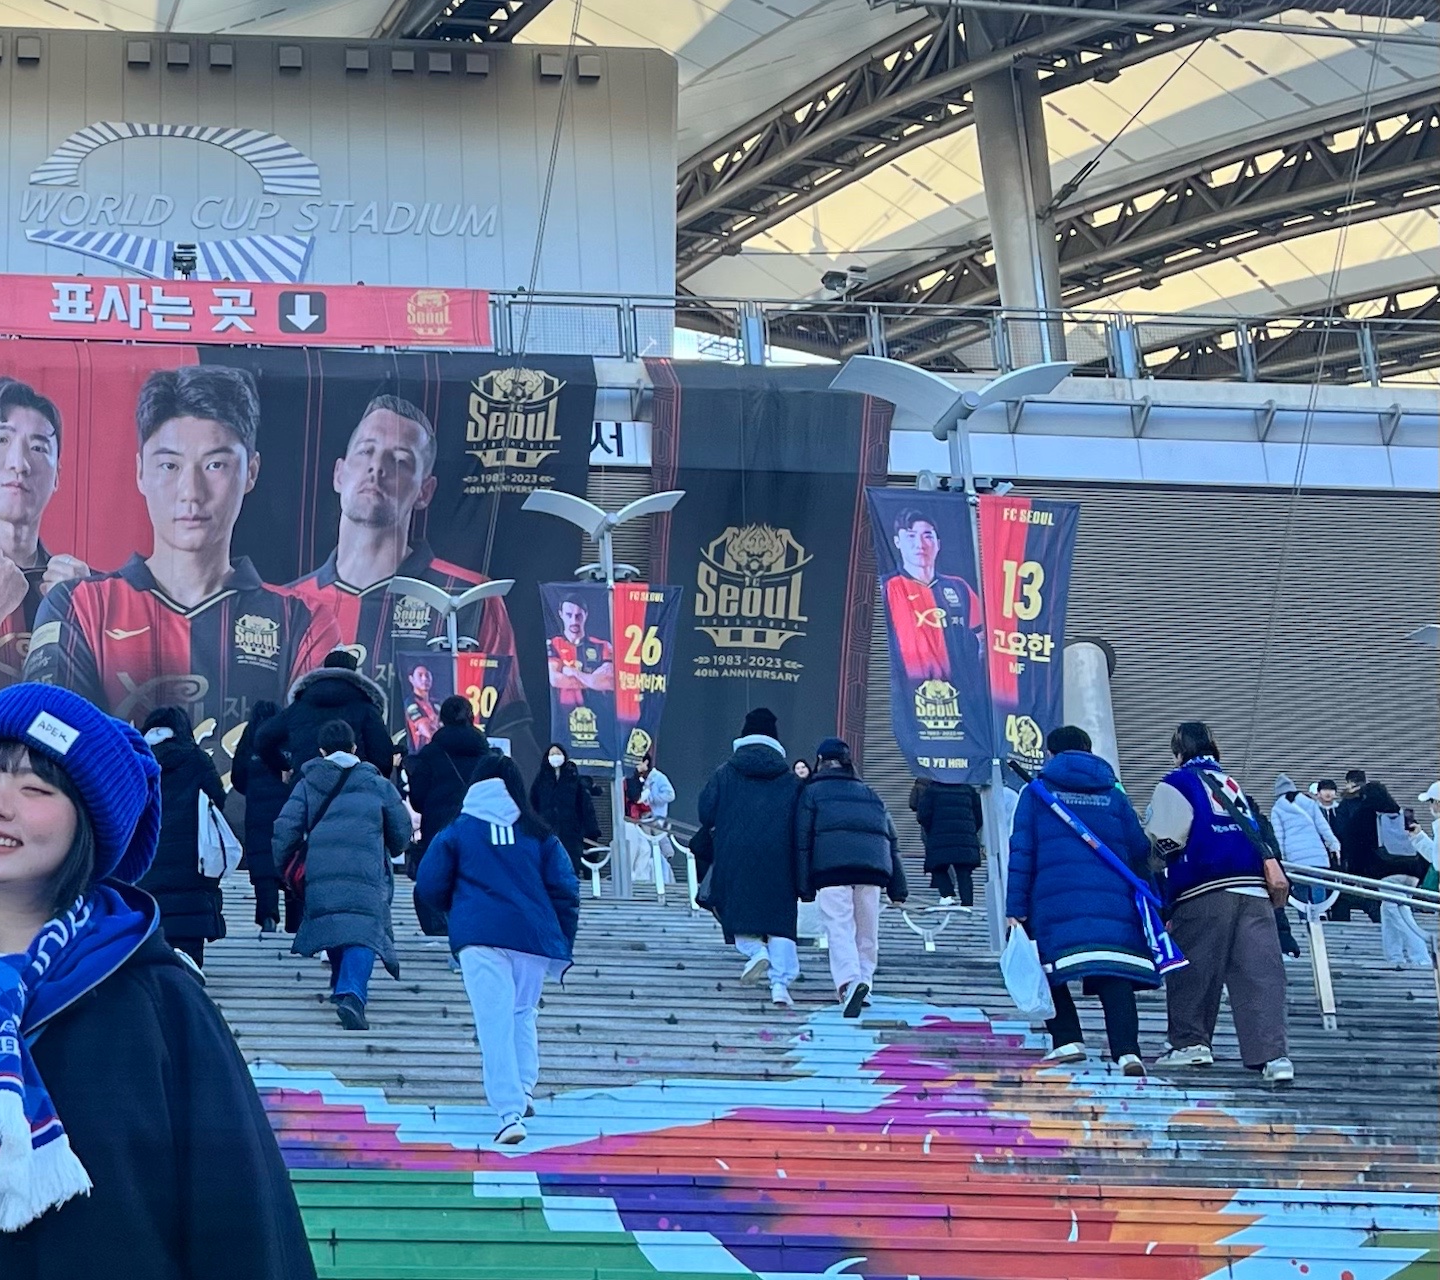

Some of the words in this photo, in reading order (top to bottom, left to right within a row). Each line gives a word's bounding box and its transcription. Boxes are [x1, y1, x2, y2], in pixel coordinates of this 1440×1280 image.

[18, 189, 175, 228] WORLD
[191, 195, 281, 231] CUP
[292, 198, 498, 237] STADIUM
[49, 281, 194, 332] 표사는
[208, 287, 257, 333] 곳
[590, 422, 624, 458] 서
[1003, 507, 1017, 522] FC
[1019, 509, 1055, 526] SEOUL
[1002, 559, 1045, 621] 13
[623, 624, 663, 666] 26
[993, 629, 1055, 663] 고요한
[693, 668, 720, 678] 40th
[721, 668, 801, 683] ANNIVERSARY
[465, 684, 499, 718] 30
